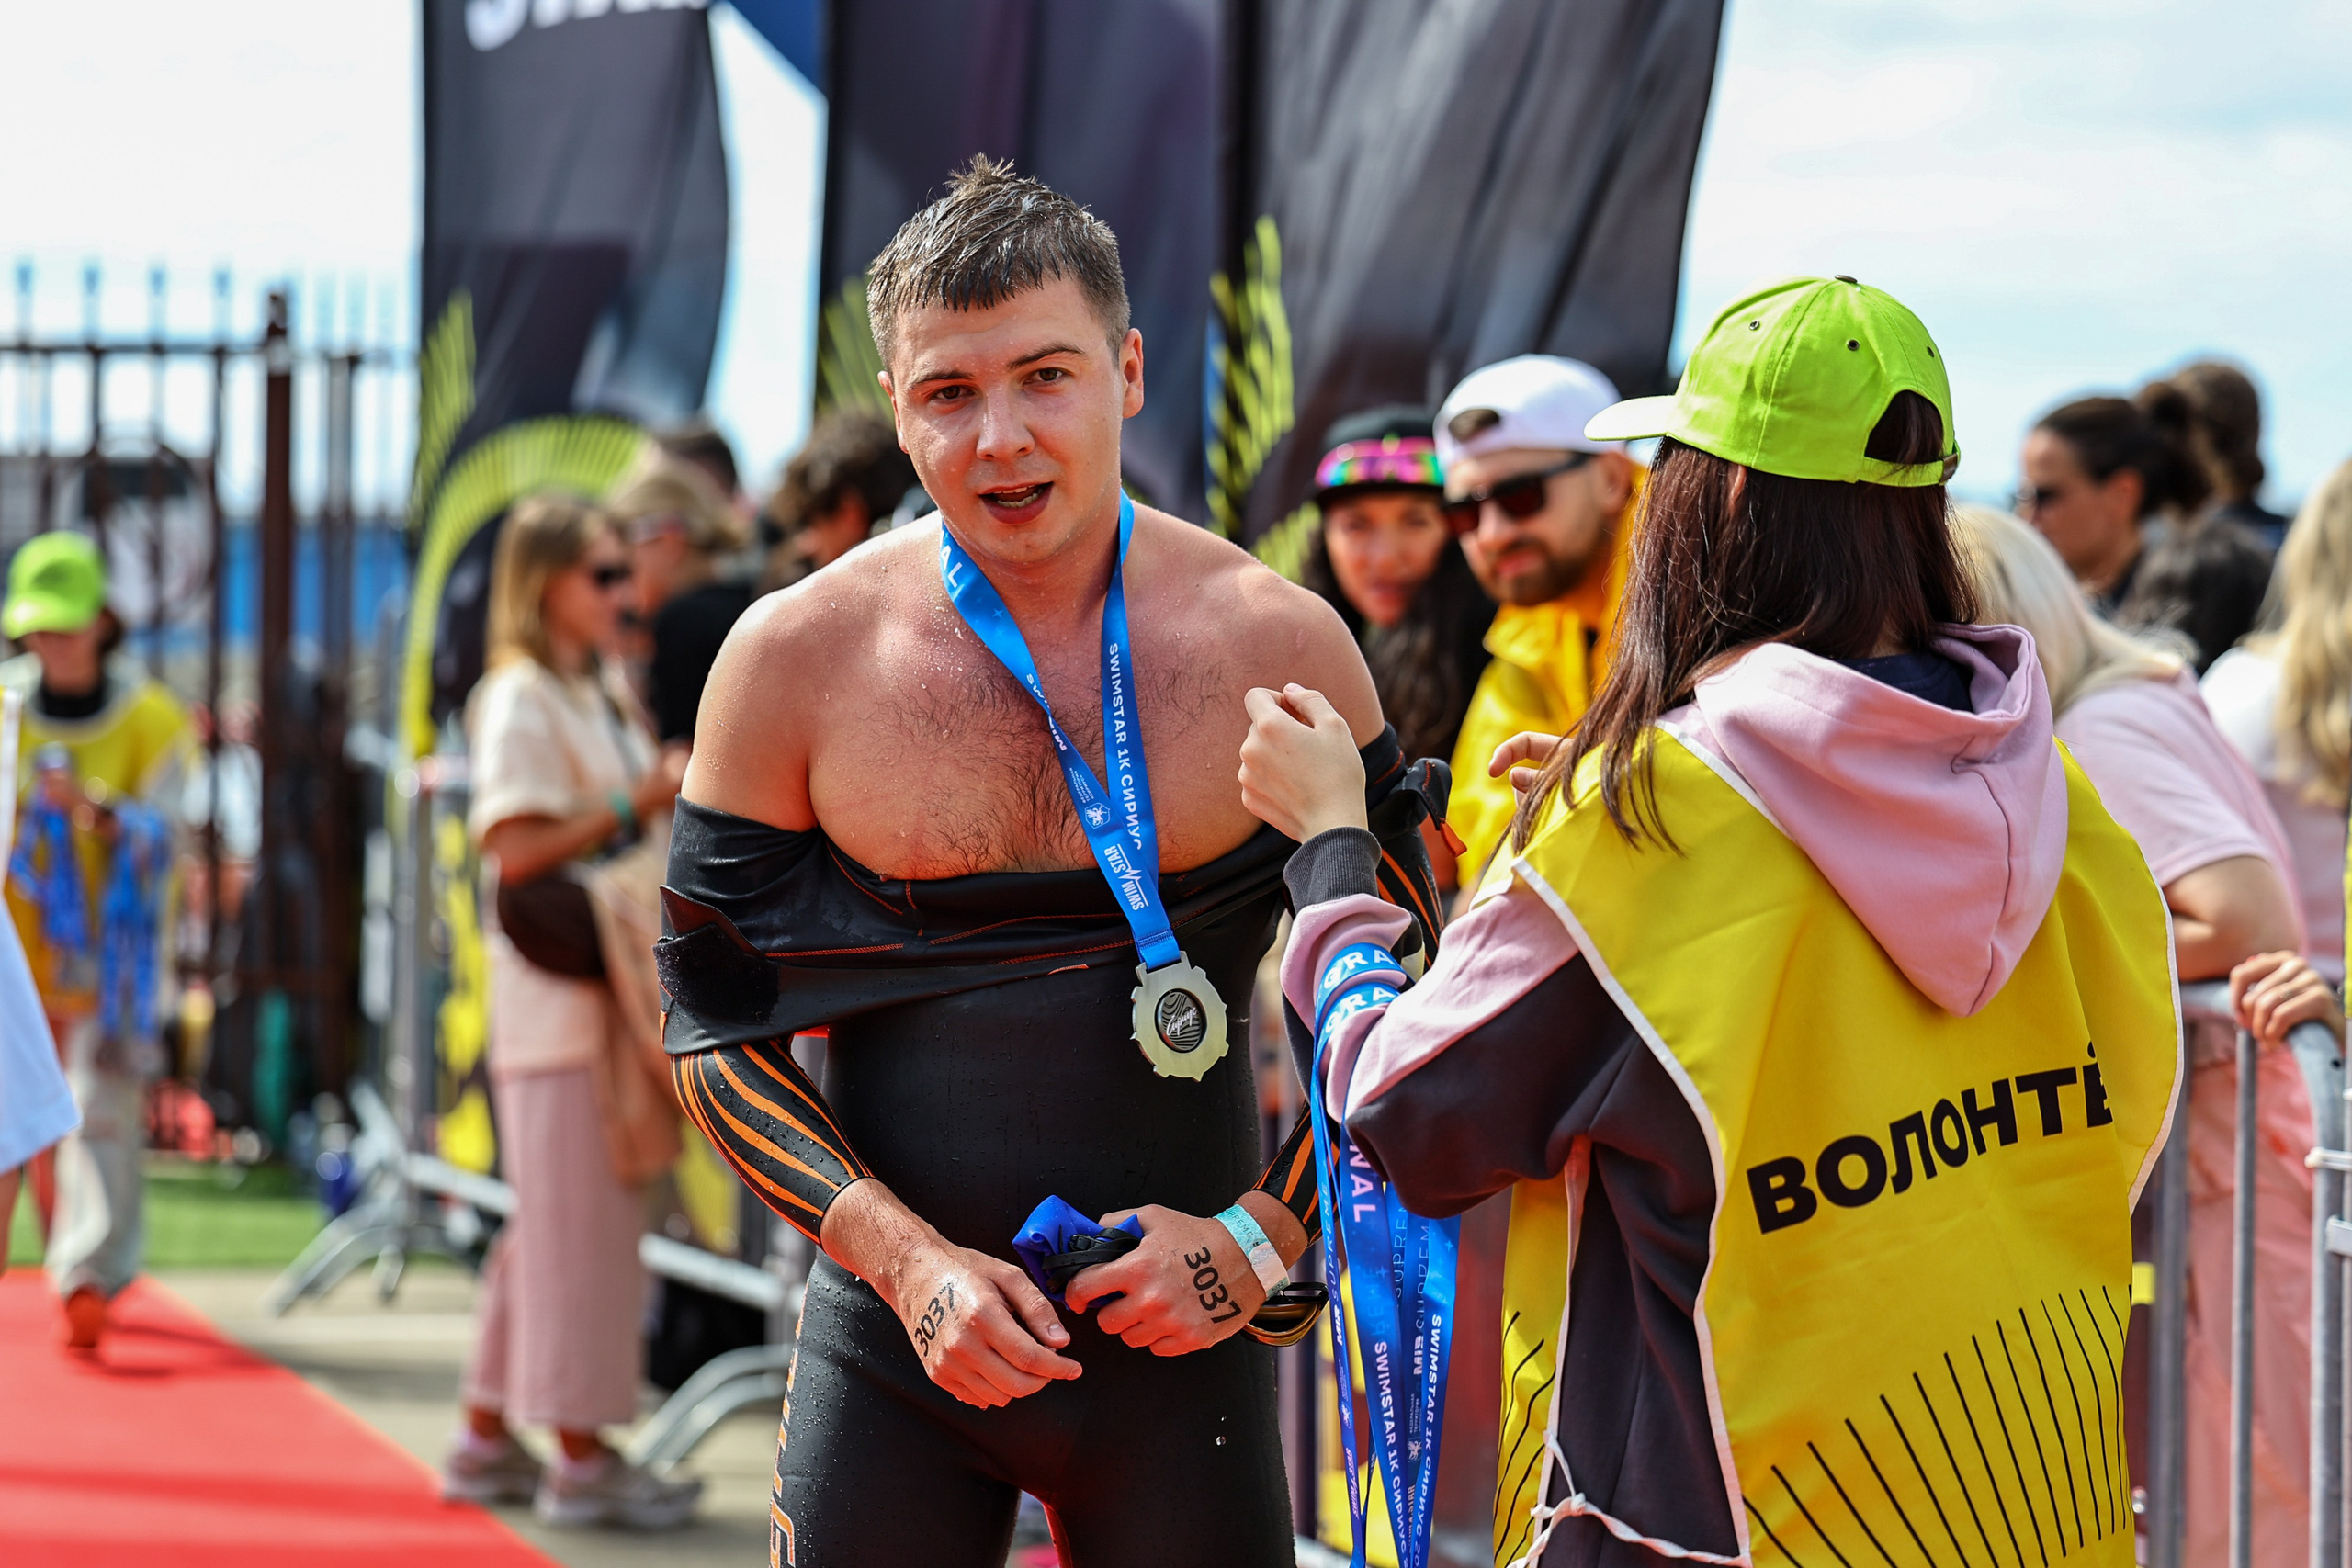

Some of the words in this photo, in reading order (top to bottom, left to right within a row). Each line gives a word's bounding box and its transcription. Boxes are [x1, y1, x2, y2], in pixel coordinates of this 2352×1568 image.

[1109, 642, 1128, 745] SWIMSTAR
[1117, 748, 1132, 771] 1K
[1103, 844, 1127, 874] STAR
[1121, 880, 1145, 911] SWIM
[1320, 1183, 1340, 1301] SUPREME
[914, 1282, 956, 1358] 3037
[1184, 1246, 1243, 1325] 3037
[1374, 1341, 1396, 1447] SWIMSTAR
[1427, 1314, 1442, 1423] SWIMSTAR
[1387, 1450, 1399, 1472] 1K
[1416, 1455, 1432, 1538] СИРИУС
[1392, 1475, 1408, 1558] СИРИУС
